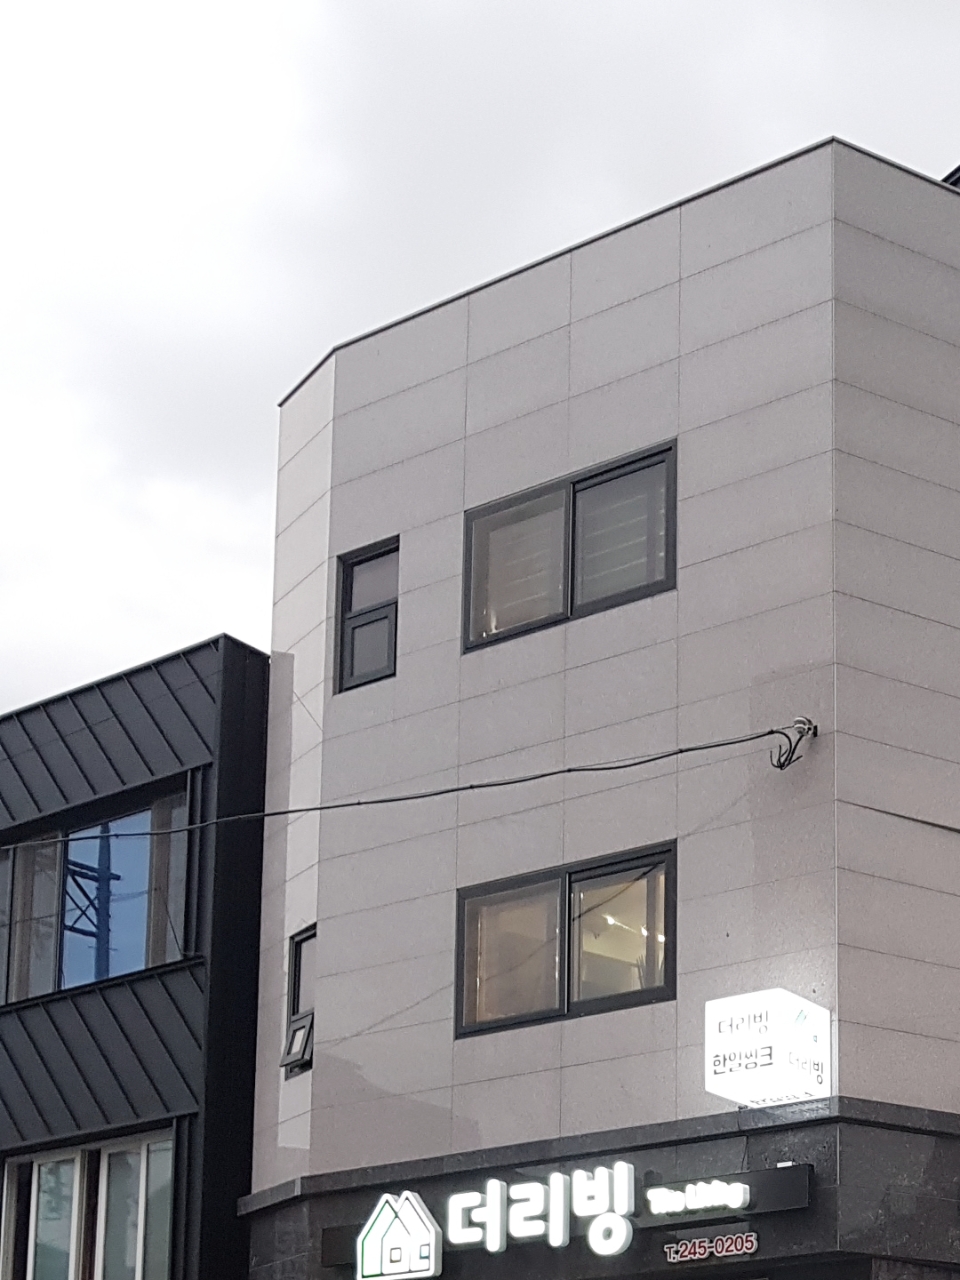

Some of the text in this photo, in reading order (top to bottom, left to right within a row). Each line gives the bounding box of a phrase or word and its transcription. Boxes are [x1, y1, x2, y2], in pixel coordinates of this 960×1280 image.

[718, 1010, 768, 1034] 더리빙
[713, 1046, 774, 1075] 한일씽크
[448, 1161, 635, 1256] 더리빙
